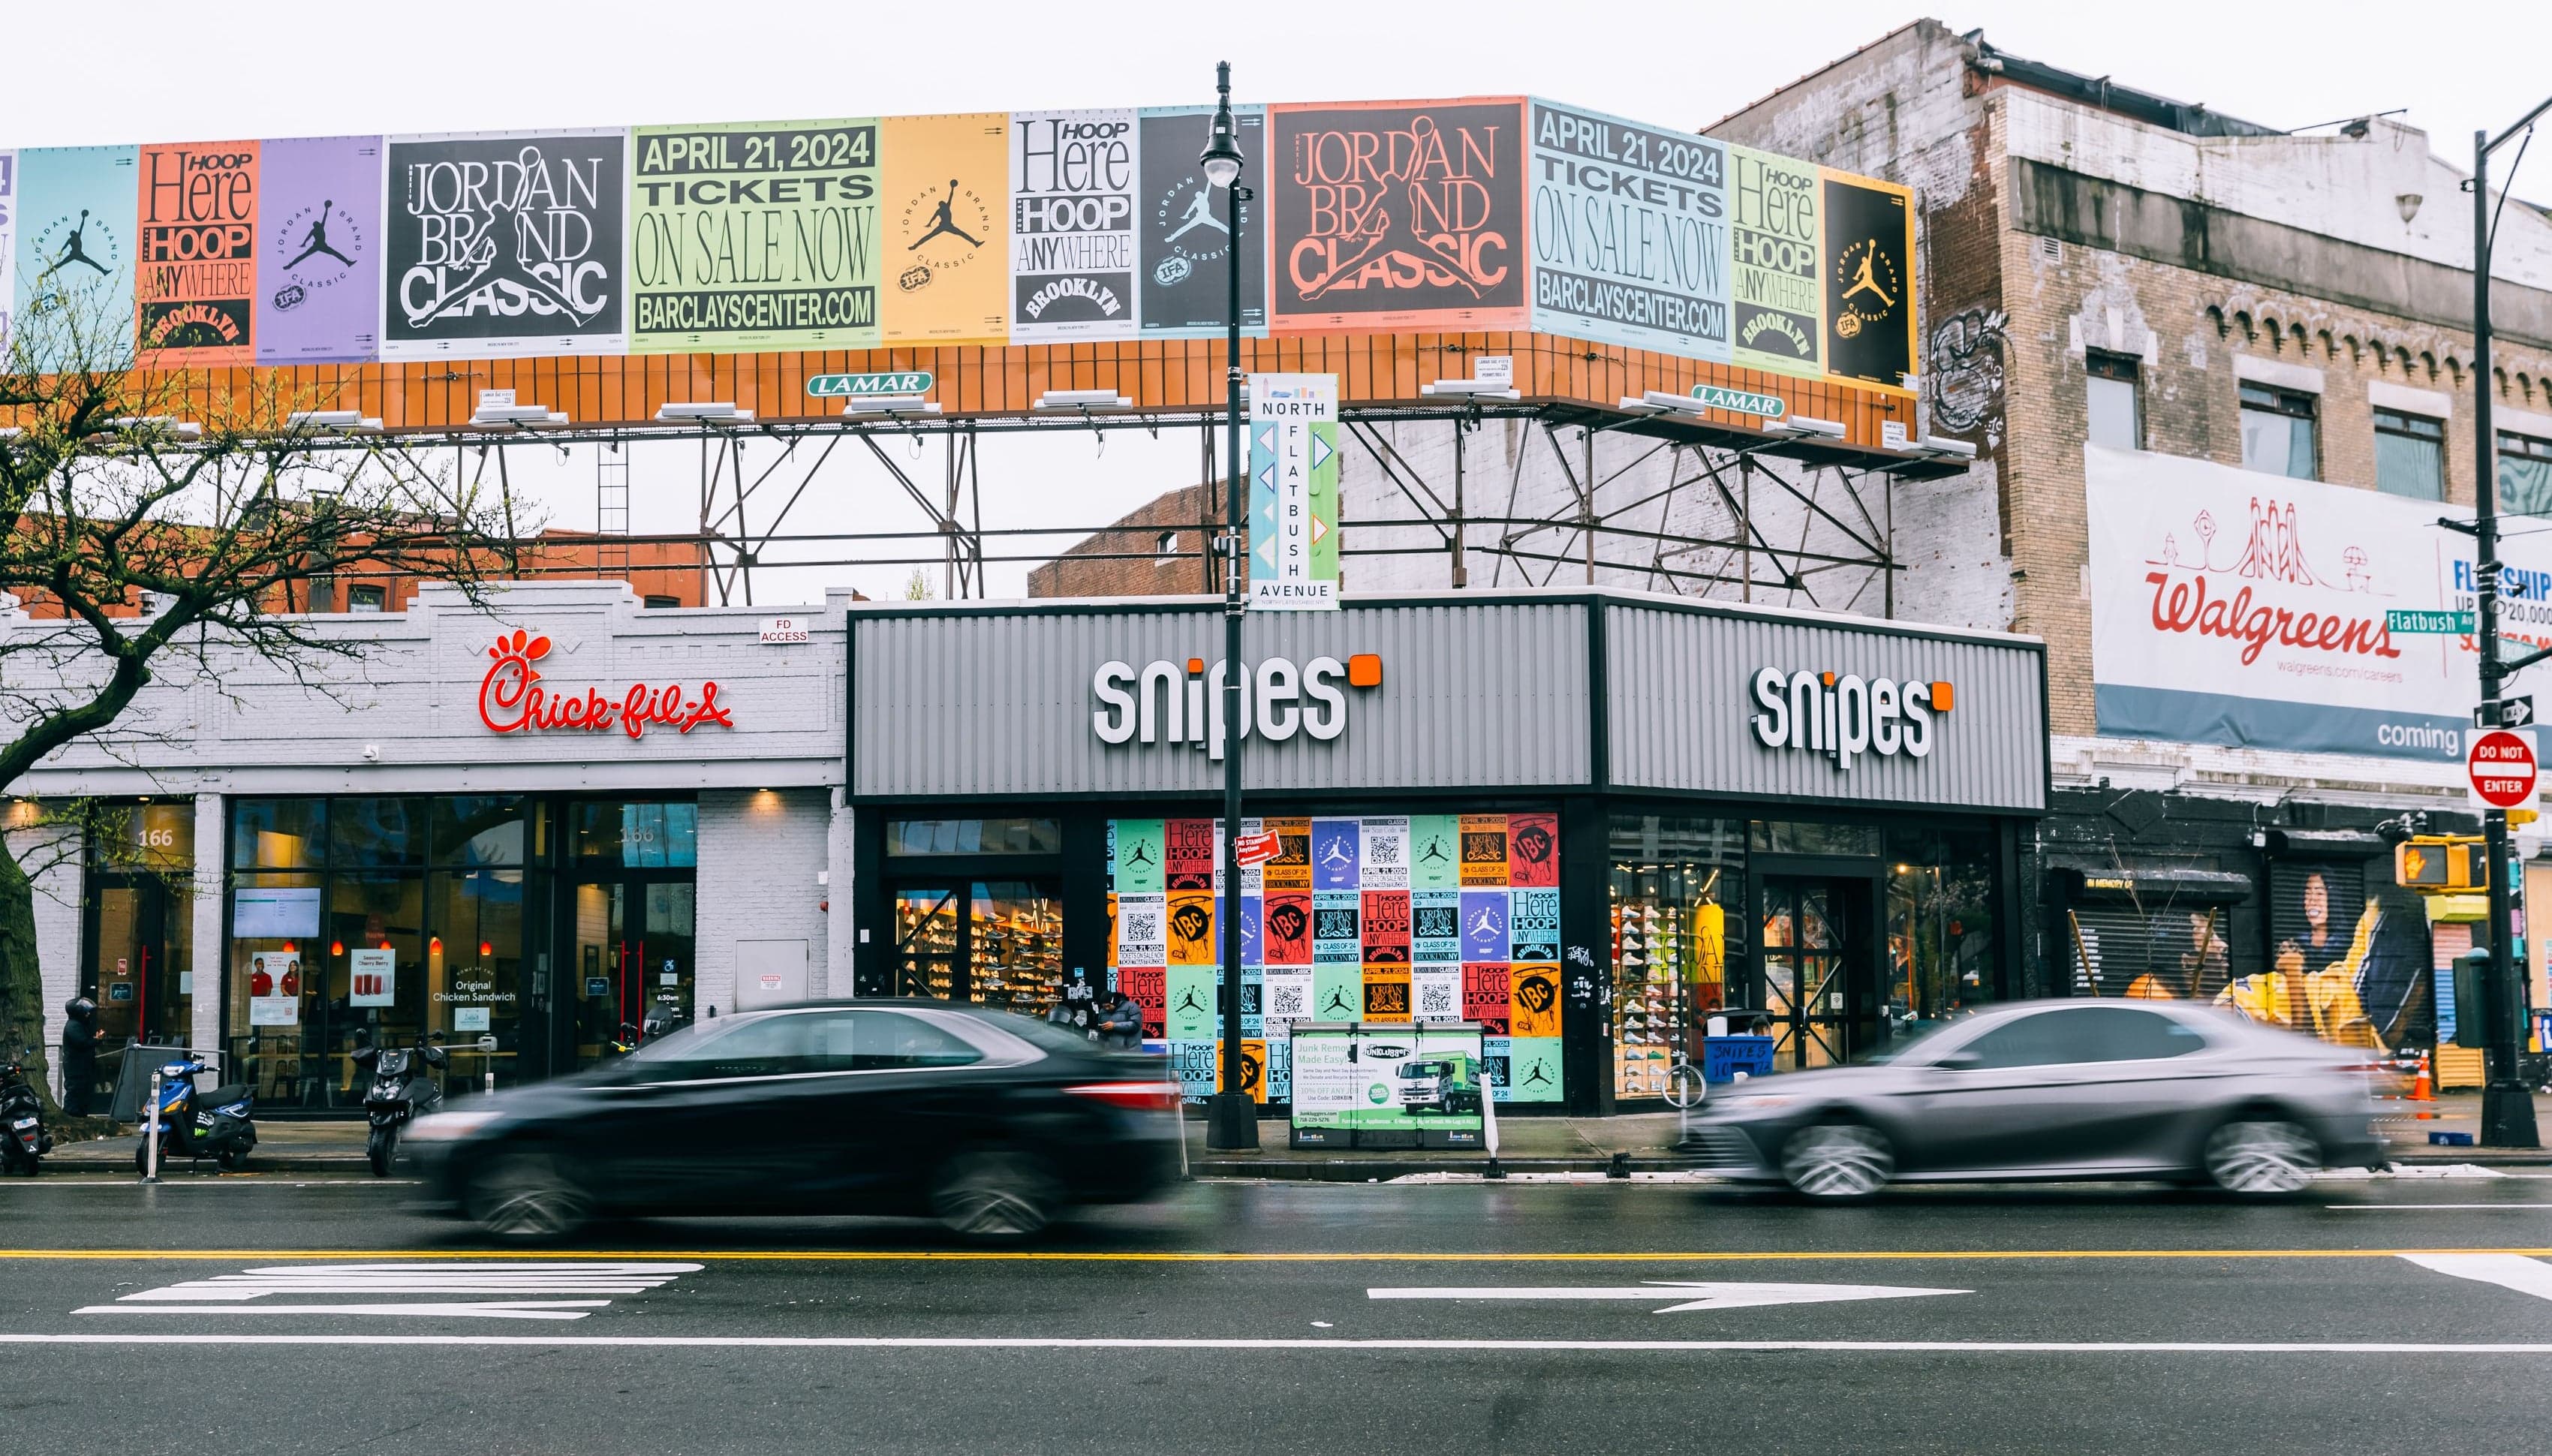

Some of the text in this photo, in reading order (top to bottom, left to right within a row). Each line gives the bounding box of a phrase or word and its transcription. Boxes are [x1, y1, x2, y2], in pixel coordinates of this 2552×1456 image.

[1061, 122, 1130, 140] HOOP
[643, 131, 870, 172] APRIL 21, 2024
[1016, 119, 1130, 193] Here
[1295, 126, 1500, 185] JORDAN
[1539, 111, 1720, 184] APRIL 21, 2024
[188, 154, 252, 171] HOOP
[143, 152, 251, 222] Here
[408, 158, 603, 215] JORDAN
[637, 175, 874, 206] TICKETS
[1535, 153, 1723, 218] TICKETS
[1765, 169, 1813, 191] HOOP
[902, 185, 989, 235] JORDAN BRAND
[1159, 176, 1194, 227] JORDAN
[1732, 154, 1814, 241] Here
[1022, 196, 1130, 233] HOOP
[35, 215, 117, 263] JORDAN BRAND
[149, 225, 251, 261] HOOP
[278, 206, 363, 255] JORDAN BRAND
[1536, 185, 1724, 296] ON SALE NOW
[636, 206, 874, 287] ON SALE NOW
[1016, 234, 1131, 271] ANYWHERE
[1174, 245, 1230, 260] CLASSIC
[1739, 229, 1815, 276] HOOP
[917, 252, 976, 269] CLASSIC
[1160, 260, 1185, 279] IFA
[1290, 231, 1508, 291] CLASSIC
[1838, 241, 1898, 293] JORDAN BRAND
[141, 263, 251, 299] ANYWHERE
[291, 272, 348, 288] CLASSIC
[400, 260, 608, 318] CLASSIC
[1735, 266, 1816, 314] ANYWHERE
[640, 290, 871, 330] BARCLAYSCENTER.COM
[1025, 278, 1121, 319] BROOKLYN
[1539, 271, 1724, 338] BARCLAYSCENTER.COM
[152, 305, 240, 343] BROOKLYN
[1849, 302, 1888, 321] CLASSIC
[1741, 312, 1811, 356] BROOKLYN
[818, 375, 919, 393] LAMAR
[1262, 403, 1324, 415] NORTH
[1699, 388, 1775, 414] LAMAR
[1289, 426, 1299, 576] FLATBUSH
[1260, 585, 1328, 597] AVENUE
[2454, 560, 2551, 601] FLSHIP
[2455, 596, 2474, 612] UP
[776, 620, 790, 629] FD
[2145, 571, 2401, 666] Walgreens
[2388, 612, 2456, 631] Flatbush
[761, 632, 808, 642] ACCESS
[479, 654, 734, 739] Chick-fil-A
[1751, 666, 1932, 769] snipes
[2378, 721, 2460, 757] coming
[2480, 746, 2523, 759] DO NOT
[2484, 781, 2523, 793] ENTER
[139, 829, 173, 846] 166
[620, 828, 654, 842] 166
[1166, 822, 1211, 847] Here
[1246, 835, 1270, 844] STANDING
[1169, 849, 1211, 859] HOOP
[1166, 861, 1211, 873] ANYWHERE
[1172, 875, 1207, 889] BROOKLYN
[2087, 879, 2094, 887] IN
[2096, 879, 2124, 889] MEMORY
[1363, 894, 1408, 919] Here
[1512, 892, 1557, 917] Here
[1366, 921, 1407, 931] HOOP
[1514, 918, 1557, 929] HOOP
[1365, 933, 1408, 945] ANYWHERE
[1512, 931, 1557, 943] ANYWHERE
[1369, 947, 1404, 961] BROOKLYN
[1518, 944, 1553, 959] BROOKLYN
[456, 981, 491, 991] Original
[1120, 970, 1164, 995] Here
[1464, 966, 1509, 991] Here
[433, 992, 516, 1001] Chicken Sandwich
[1465, 994, 1507, 1004] HOOP
[1464, 1006, 1509, 1018] ANYWHERE
[1171, 1043, 1214, 1069] Here
[1325, 1055, 1347, 1065] Easy!
